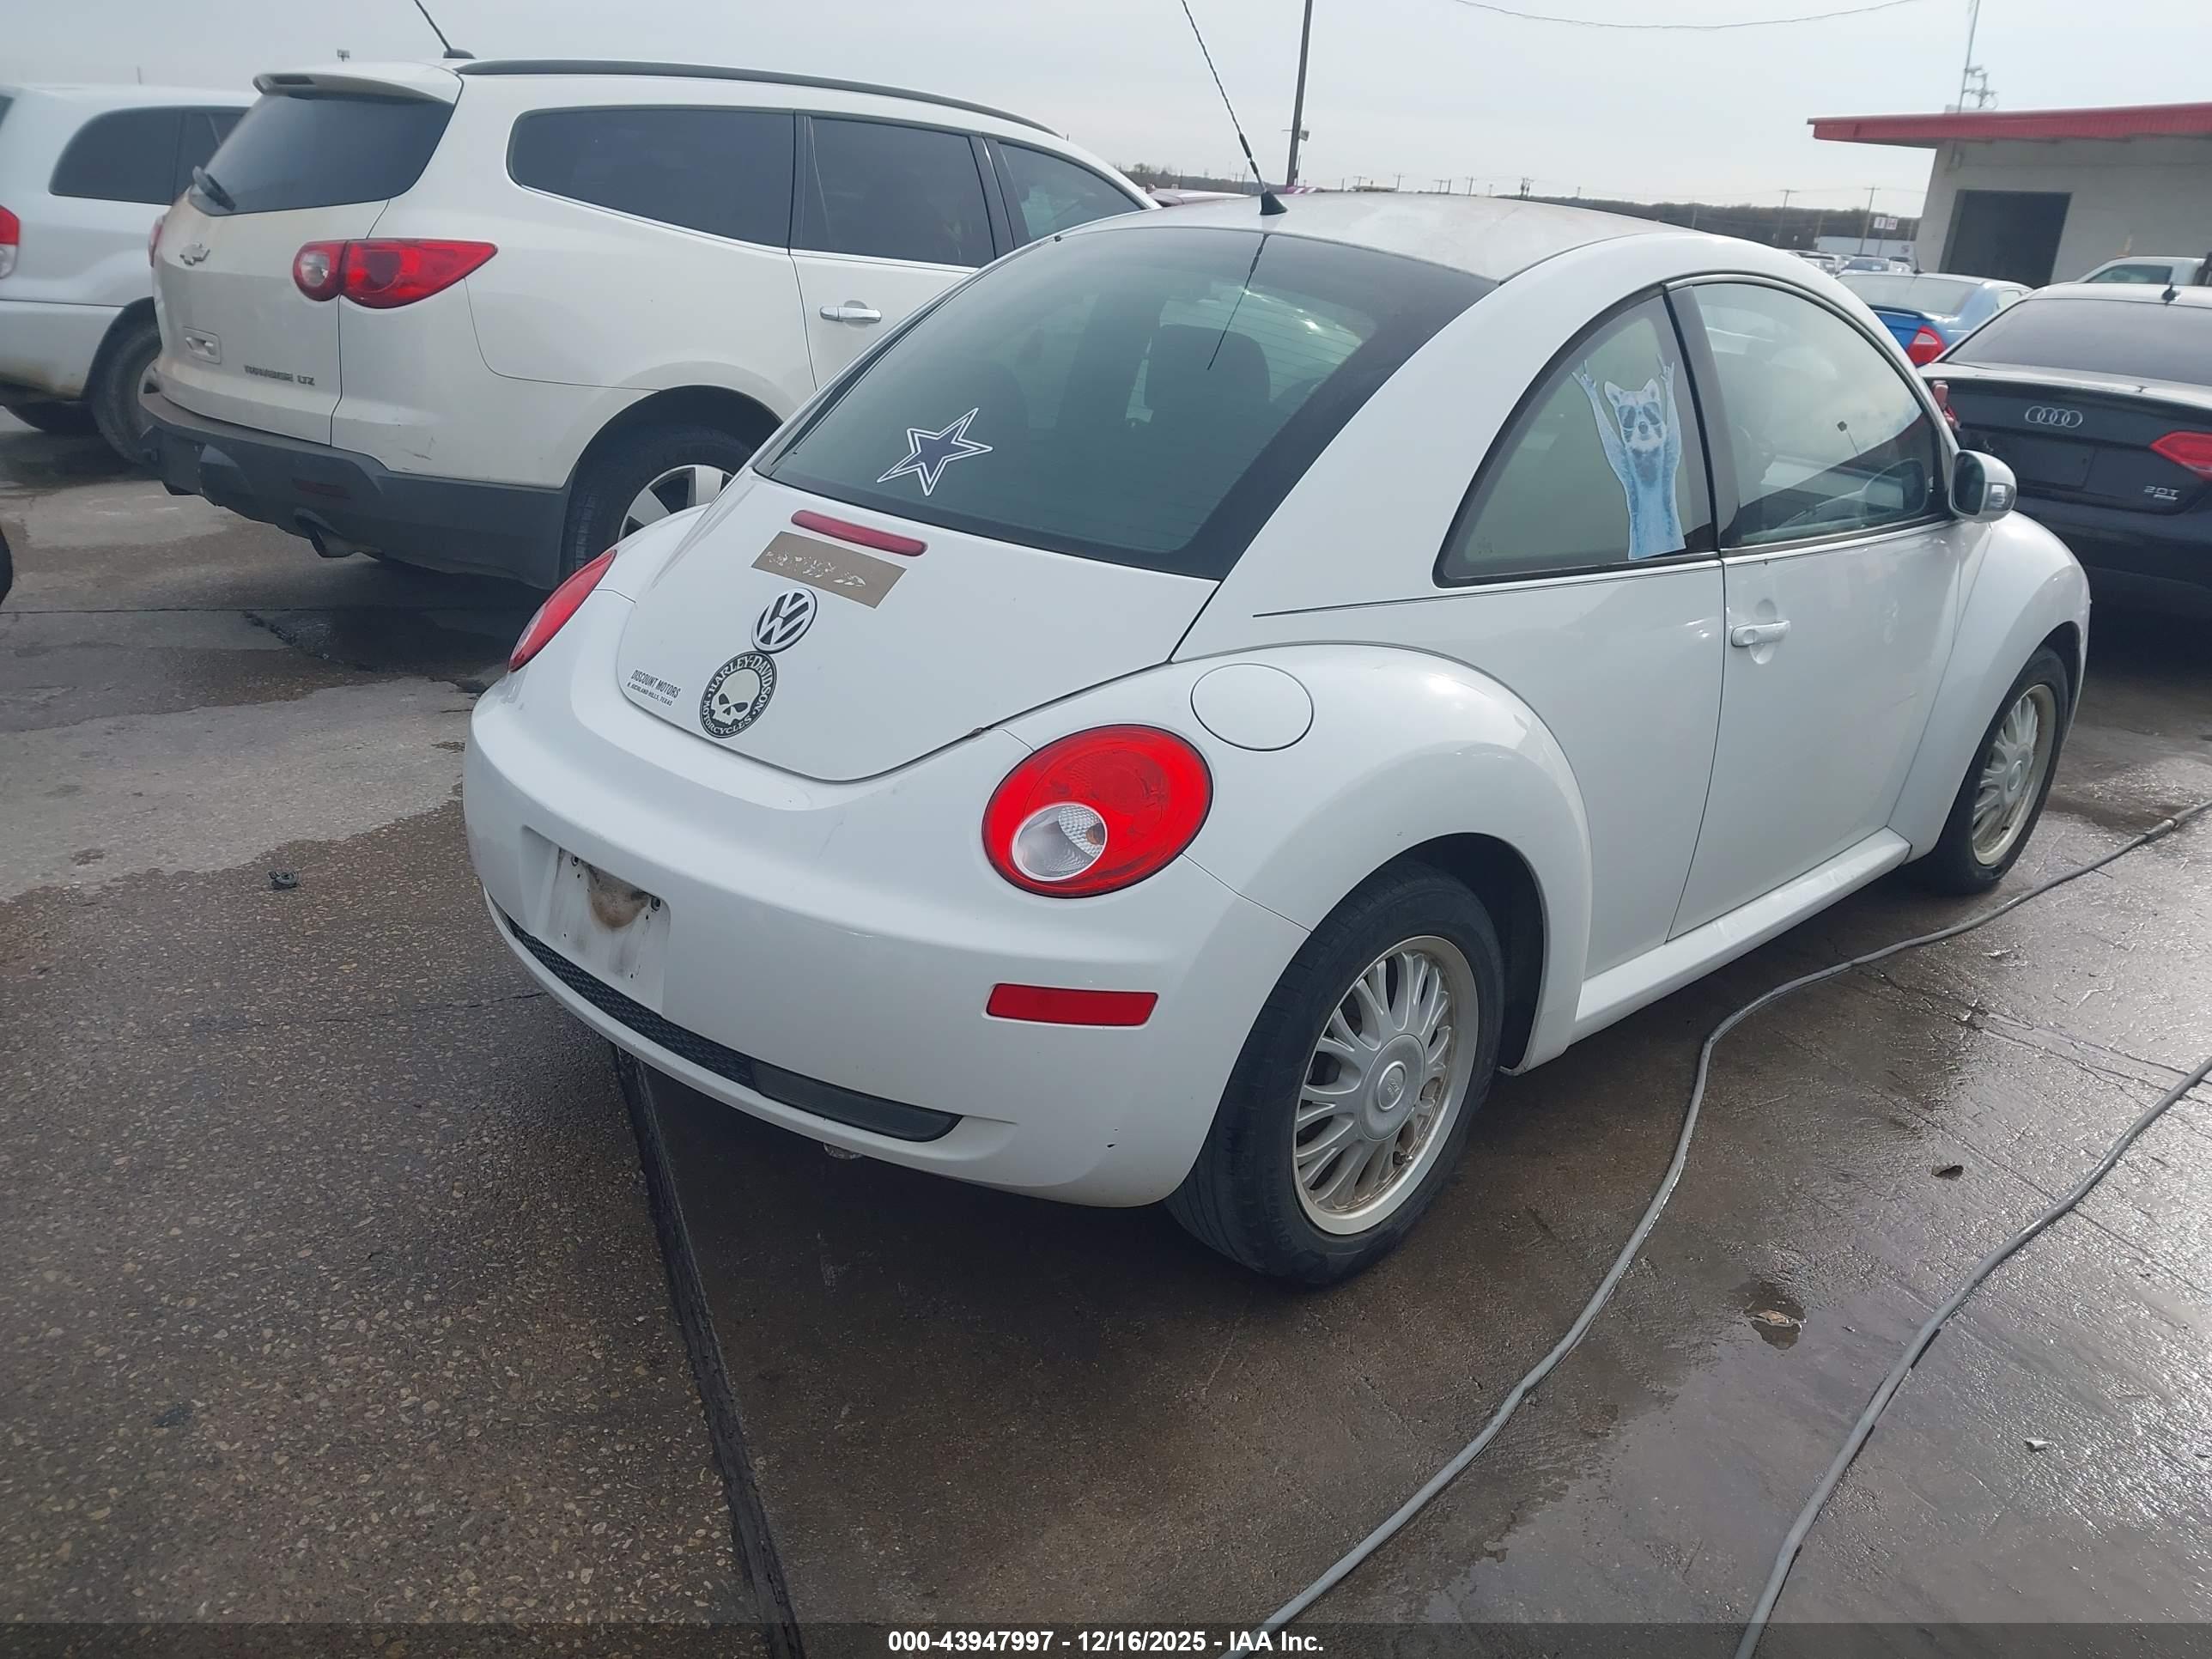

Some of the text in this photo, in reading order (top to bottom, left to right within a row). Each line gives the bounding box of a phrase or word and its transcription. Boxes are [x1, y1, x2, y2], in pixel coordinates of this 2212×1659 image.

[297, 375, 315, 386] LTZ
[753, 589, 813, 650] VW
[631, 670, 681, 698] DISCOUNT MOTORS
[708, 655, 773, 712] HARLEY-DAVIDSON
[703, 700, 751, 734] MOTORCYCLES
